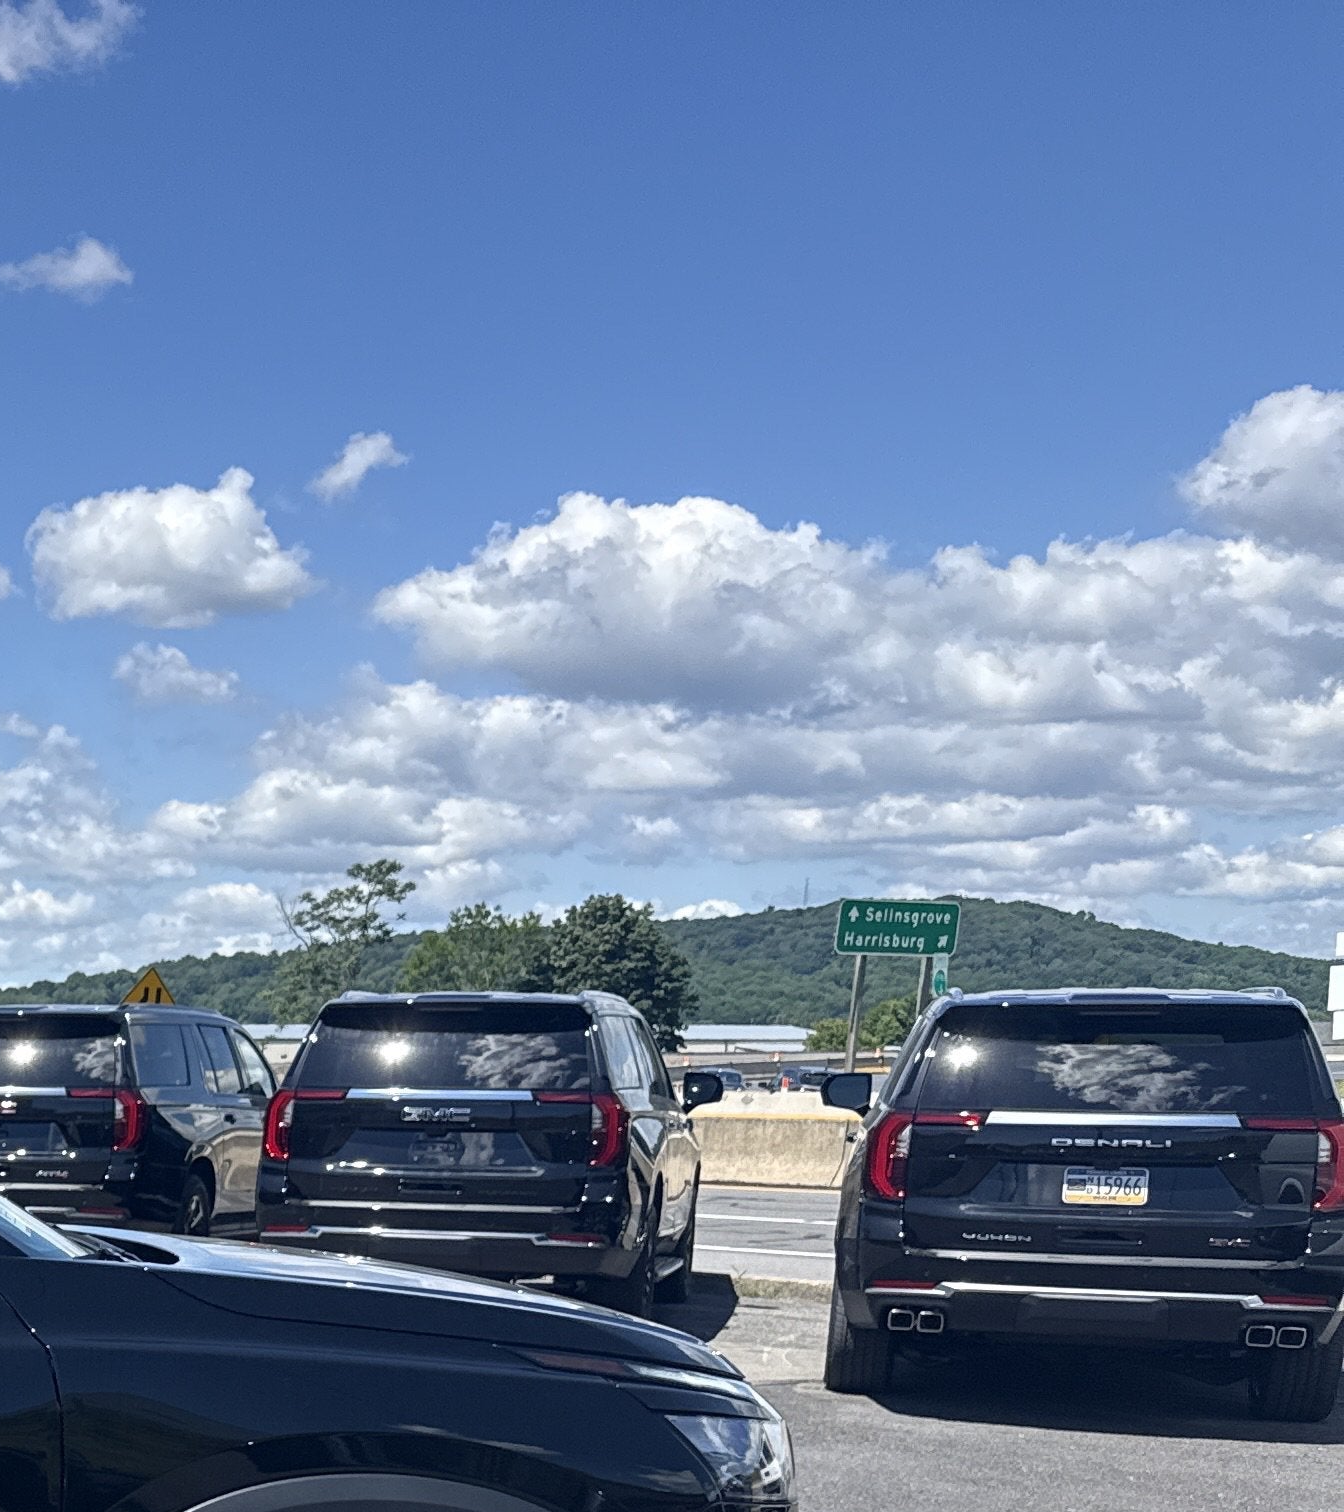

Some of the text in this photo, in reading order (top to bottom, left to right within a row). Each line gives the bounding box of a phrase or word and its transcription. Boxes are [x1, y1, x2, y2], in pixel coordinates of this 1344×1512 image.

[865, 906, 951, 928] Selinsgrove
[843, 931, 926, 952] Harrisburg
[400, 1106, 471, 1122] GMC
[1051, 1137, 1172, 1148] DENALI
[1095, 1177, 1143, 1197] 15966
